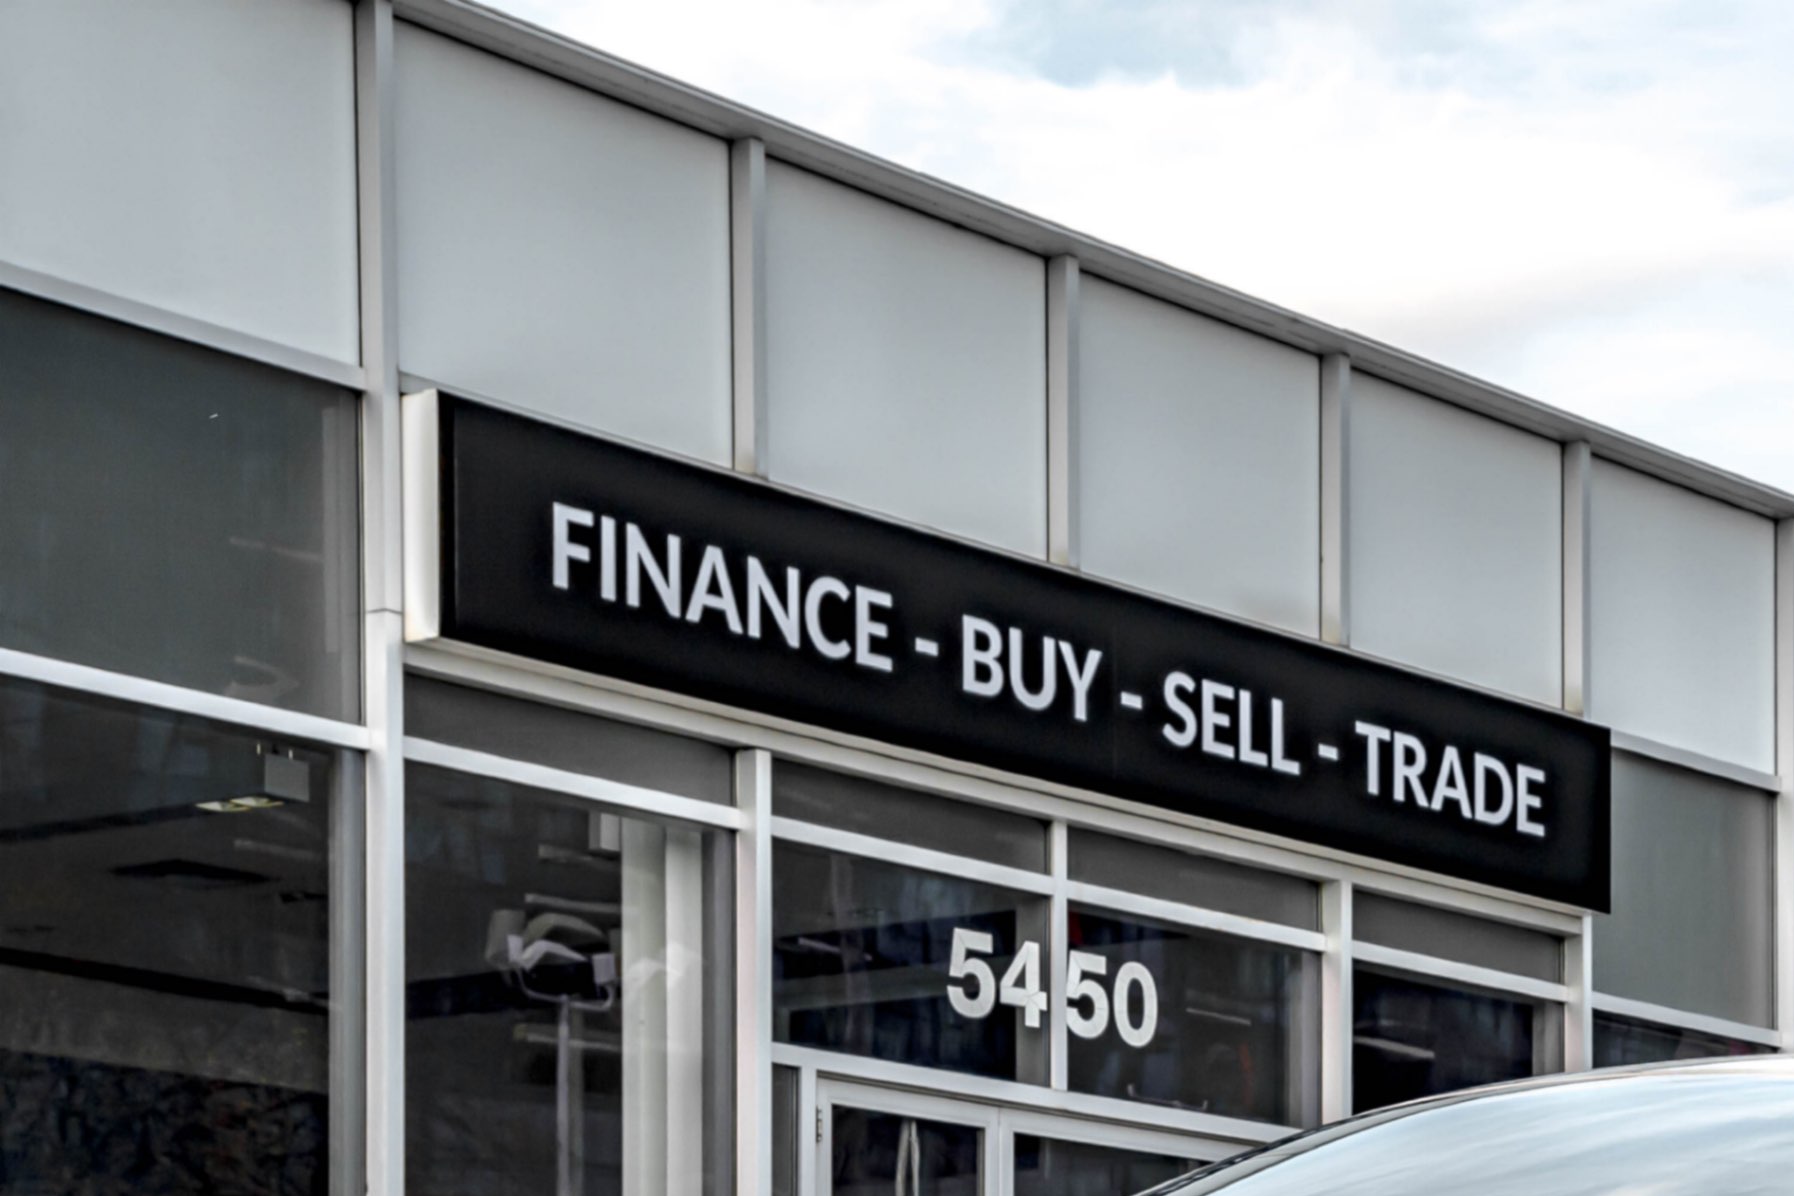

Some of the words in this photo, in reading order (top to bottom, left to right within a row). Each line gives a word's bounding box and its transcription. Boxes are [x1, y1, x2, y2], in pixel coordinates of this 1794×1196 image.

[552, 501, 893, 672] FINANCE
[961, 614, 1103, 722] BUY
[1162, 671, 1301, 776] SELL
[1354, 720, 1546, 837] TRADE
[946, 927, 1158, 1048] 5450
